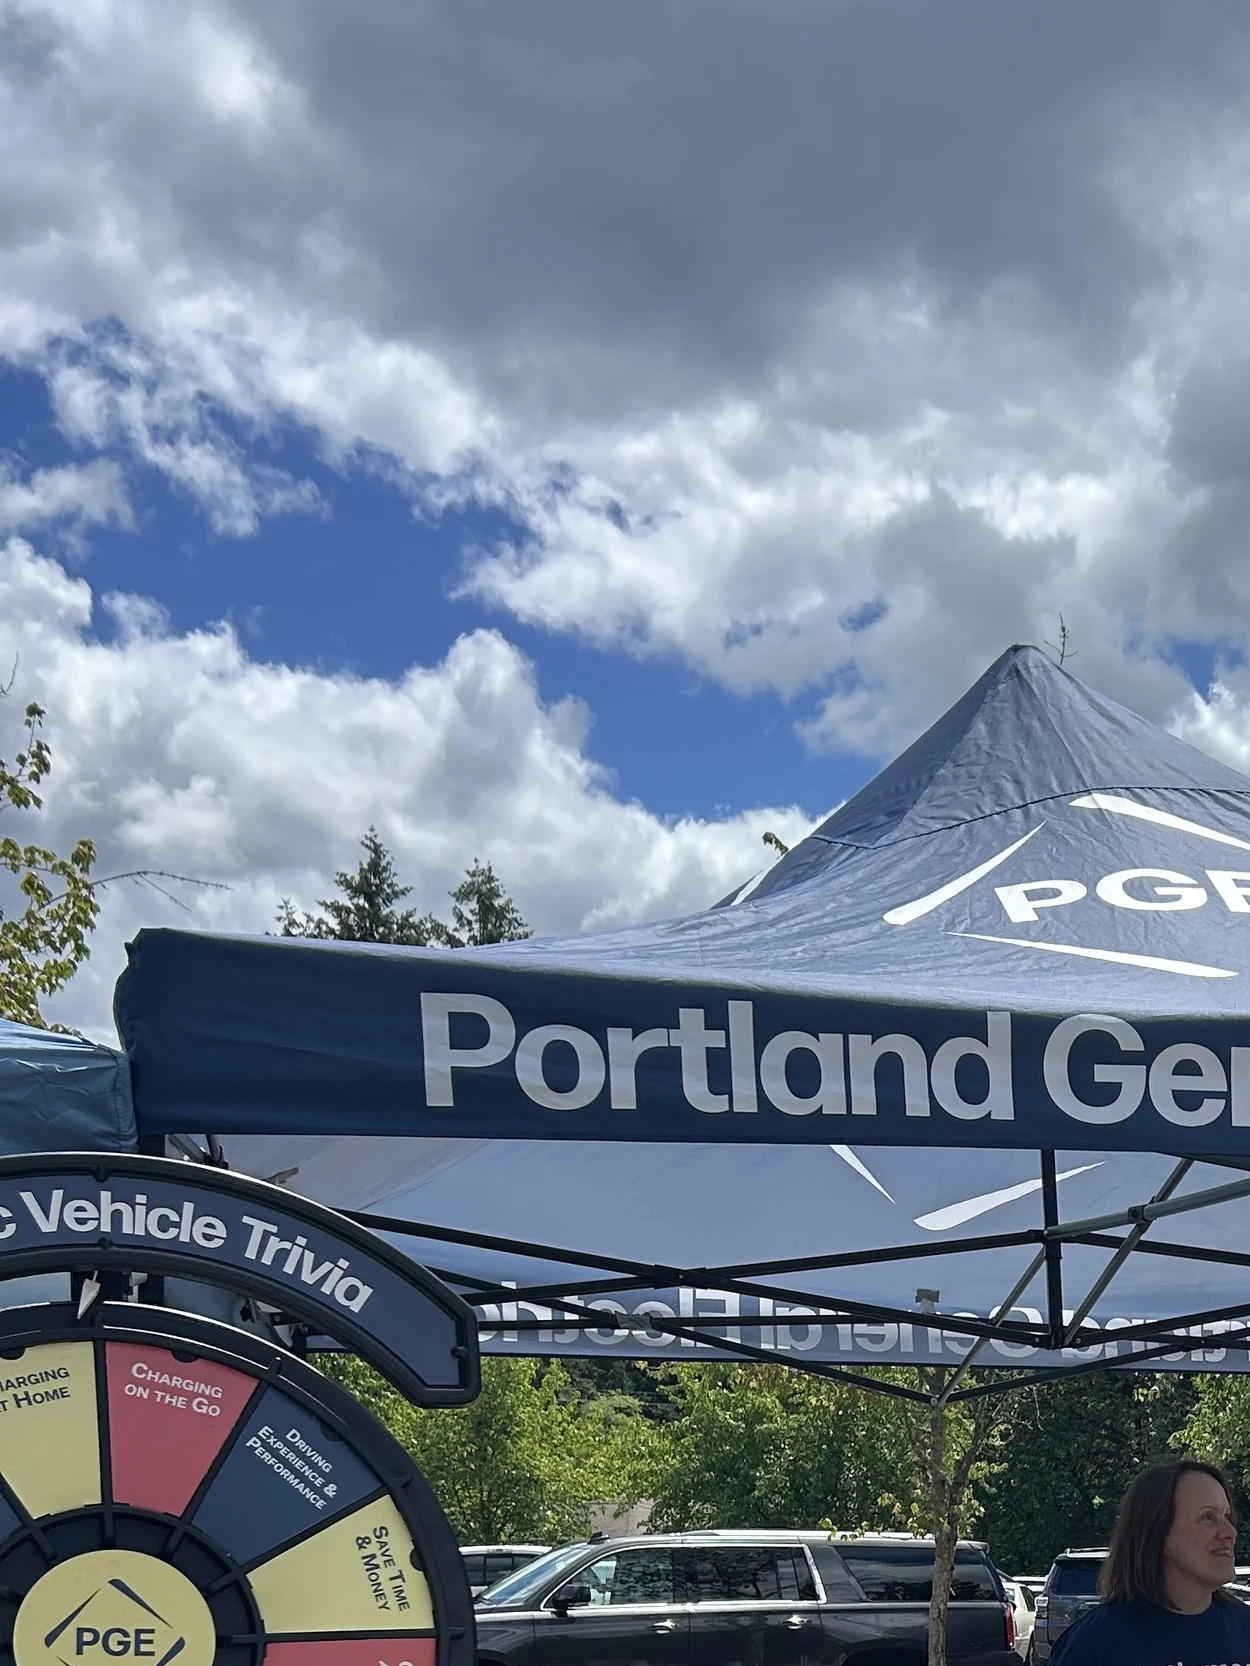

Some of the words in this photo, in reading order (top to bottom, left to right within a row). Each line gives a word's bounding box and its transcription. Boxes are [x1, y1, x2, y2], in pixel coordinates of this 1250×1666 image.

[419, 992, 1015, 1122] Portland
[19, 1189, 227, 1249] Vehicle
[242, 1215, 374, 1313] Trivia
[12, 1386, 71, 1409] HOME
[124, 1384, 149, 1399] ON
[154, 1391, 187, 1409] THE
[131, 1362, 223, 1398] CHARGING
[245, 1436, 327, 1510] PERFORMANCE
[257, 1425, 326, 1488] EXPERIENCE
[323, 1483, 338, 1498] &
[285, 1428, 333, 1473] DRIVING
[355, 1535, 372, 1551] &
[373, 1525, 396, 1568] SAVE
[389, 1569, 411, 1612] TIME
[361, 1553, 391, 1611] MONEY
[76, 1627, 156, 1657] PGE
